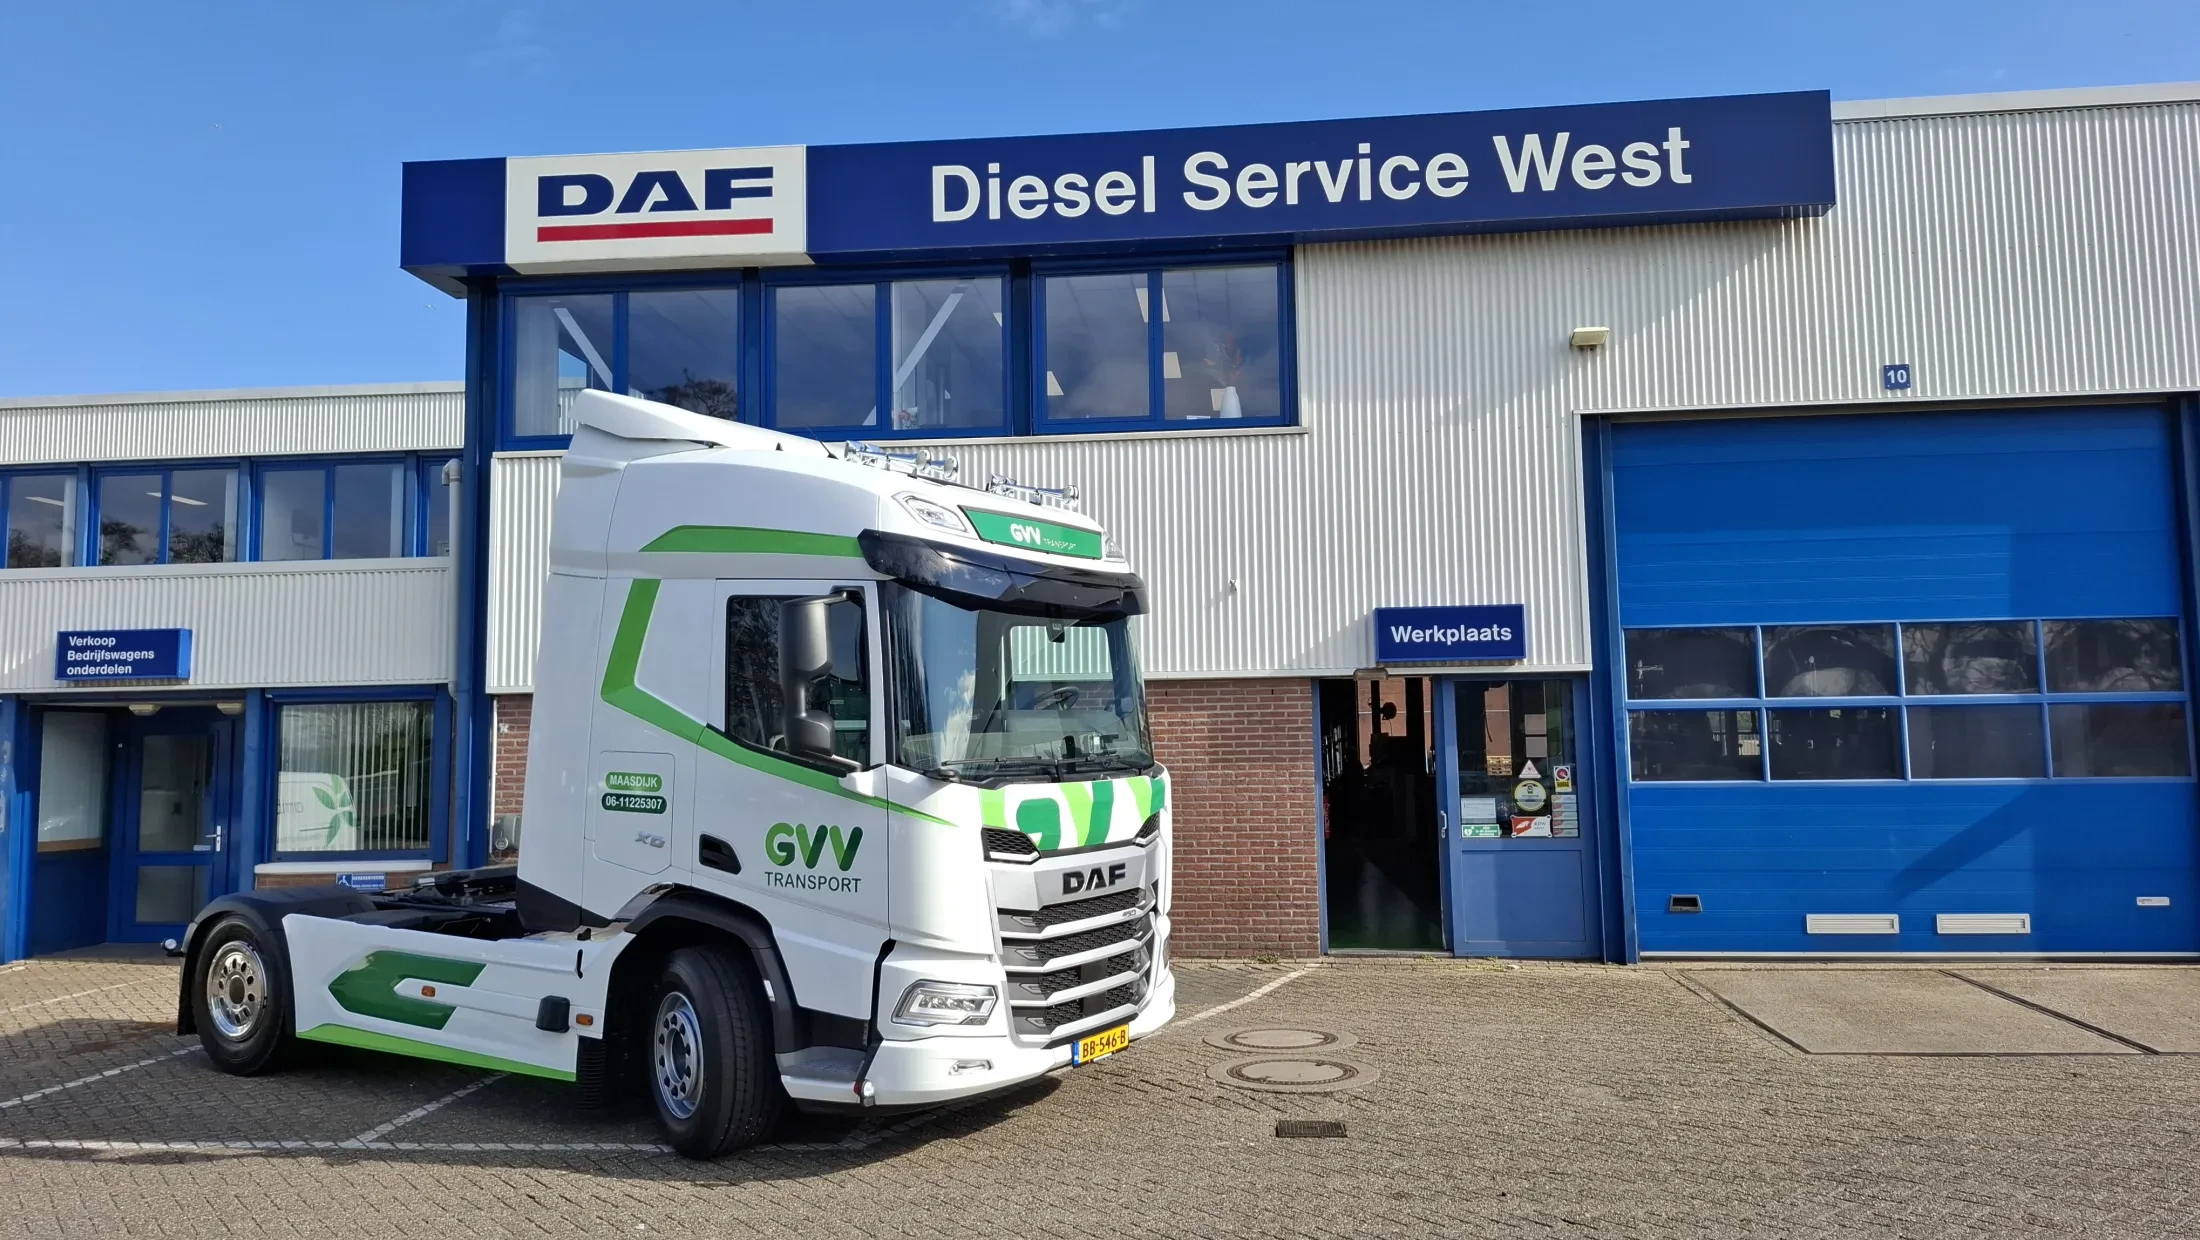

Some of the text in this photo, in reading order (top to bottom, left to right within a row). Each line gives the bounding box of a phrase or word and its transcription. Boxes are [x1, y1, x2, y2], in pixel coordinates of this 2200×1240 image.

[932, 126, 1692, 222] Diesel Service West
[537, 166, 774, 218] DAF
[1887, 369, 1908, 384] 10
[1010, 523, 1041, 545] GVV
[69, 635, 116, 648] Verkoop
[1390, 623, 1512, 646] Werkplaats
[67, 649, 155, 663] Bedrijfswagens
[67, 664, 132, 676] onderdelen
[609, 774, 659, 788] MAASDIJK
[605, 795, 663, 810] 06-11225307
[764, 822, 864, 872] GVV
[764, 871, 862, 894] TRANSPORT
[1062, 863, 1127, 896] DAF
[1082, 1029, 1126, 1058] BB-546-B
